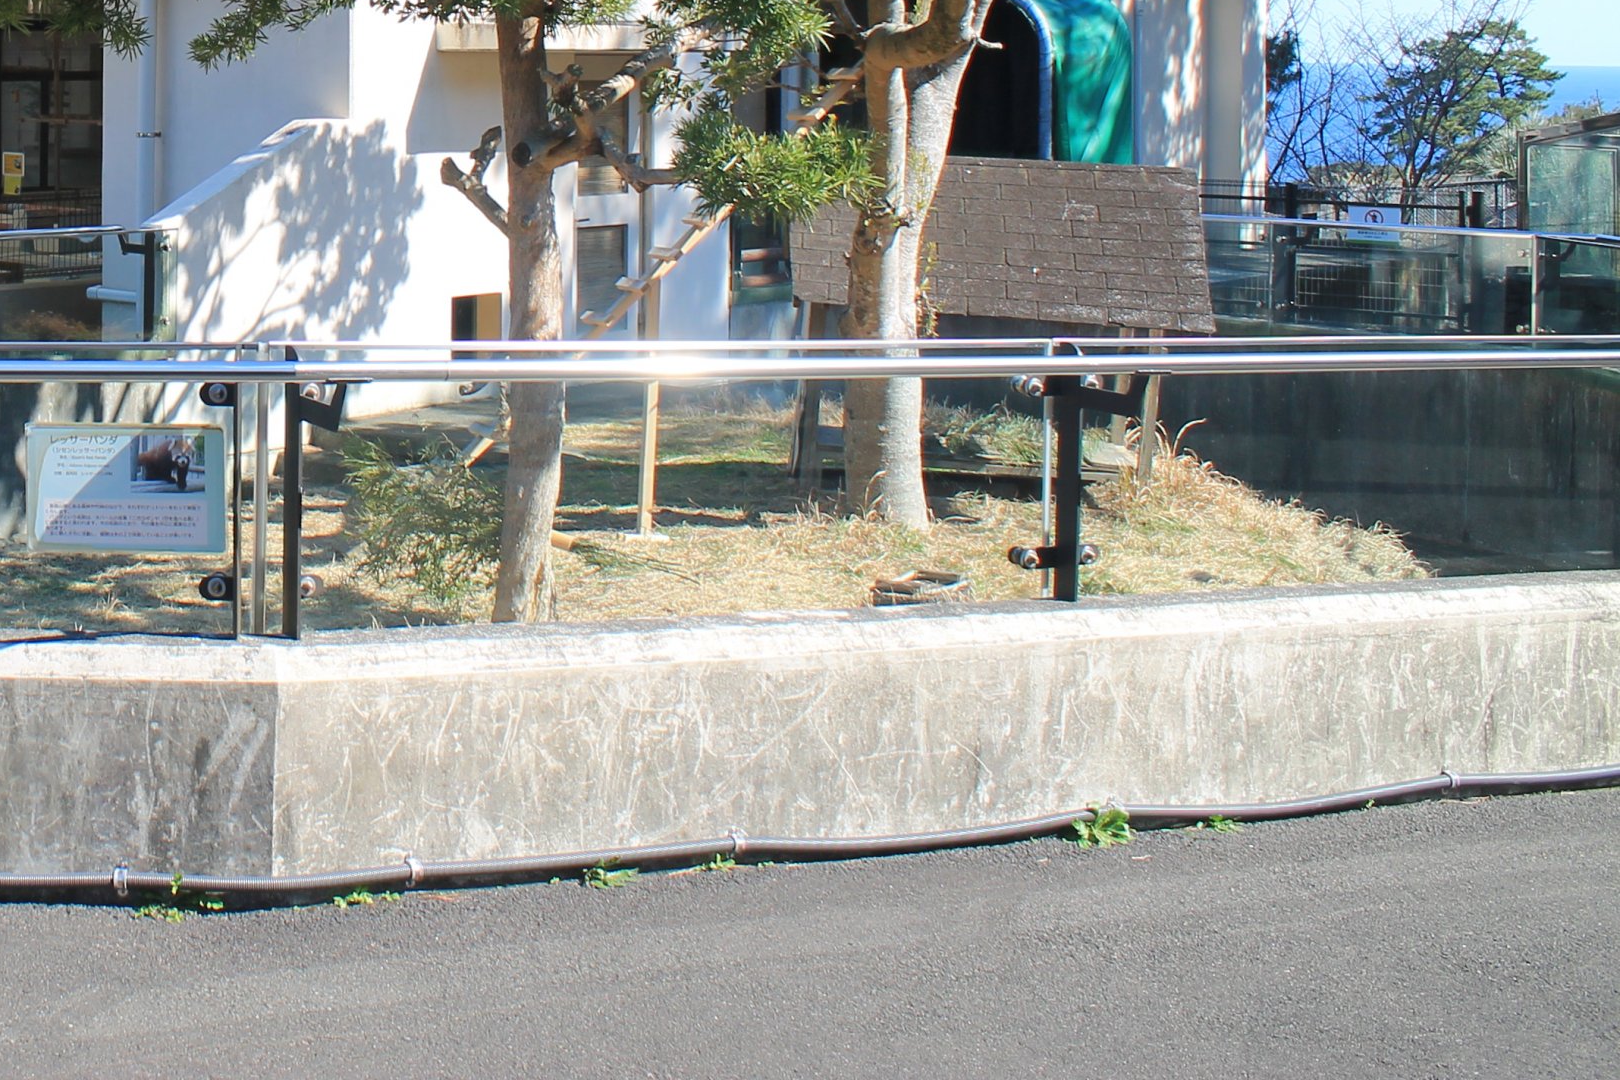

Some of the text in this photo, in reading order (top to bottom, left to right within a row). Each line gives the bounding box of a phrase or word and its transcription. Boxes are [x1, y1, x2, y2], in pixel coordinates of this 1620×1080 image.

[50, 434, 118, 446] レッサーパンダ
